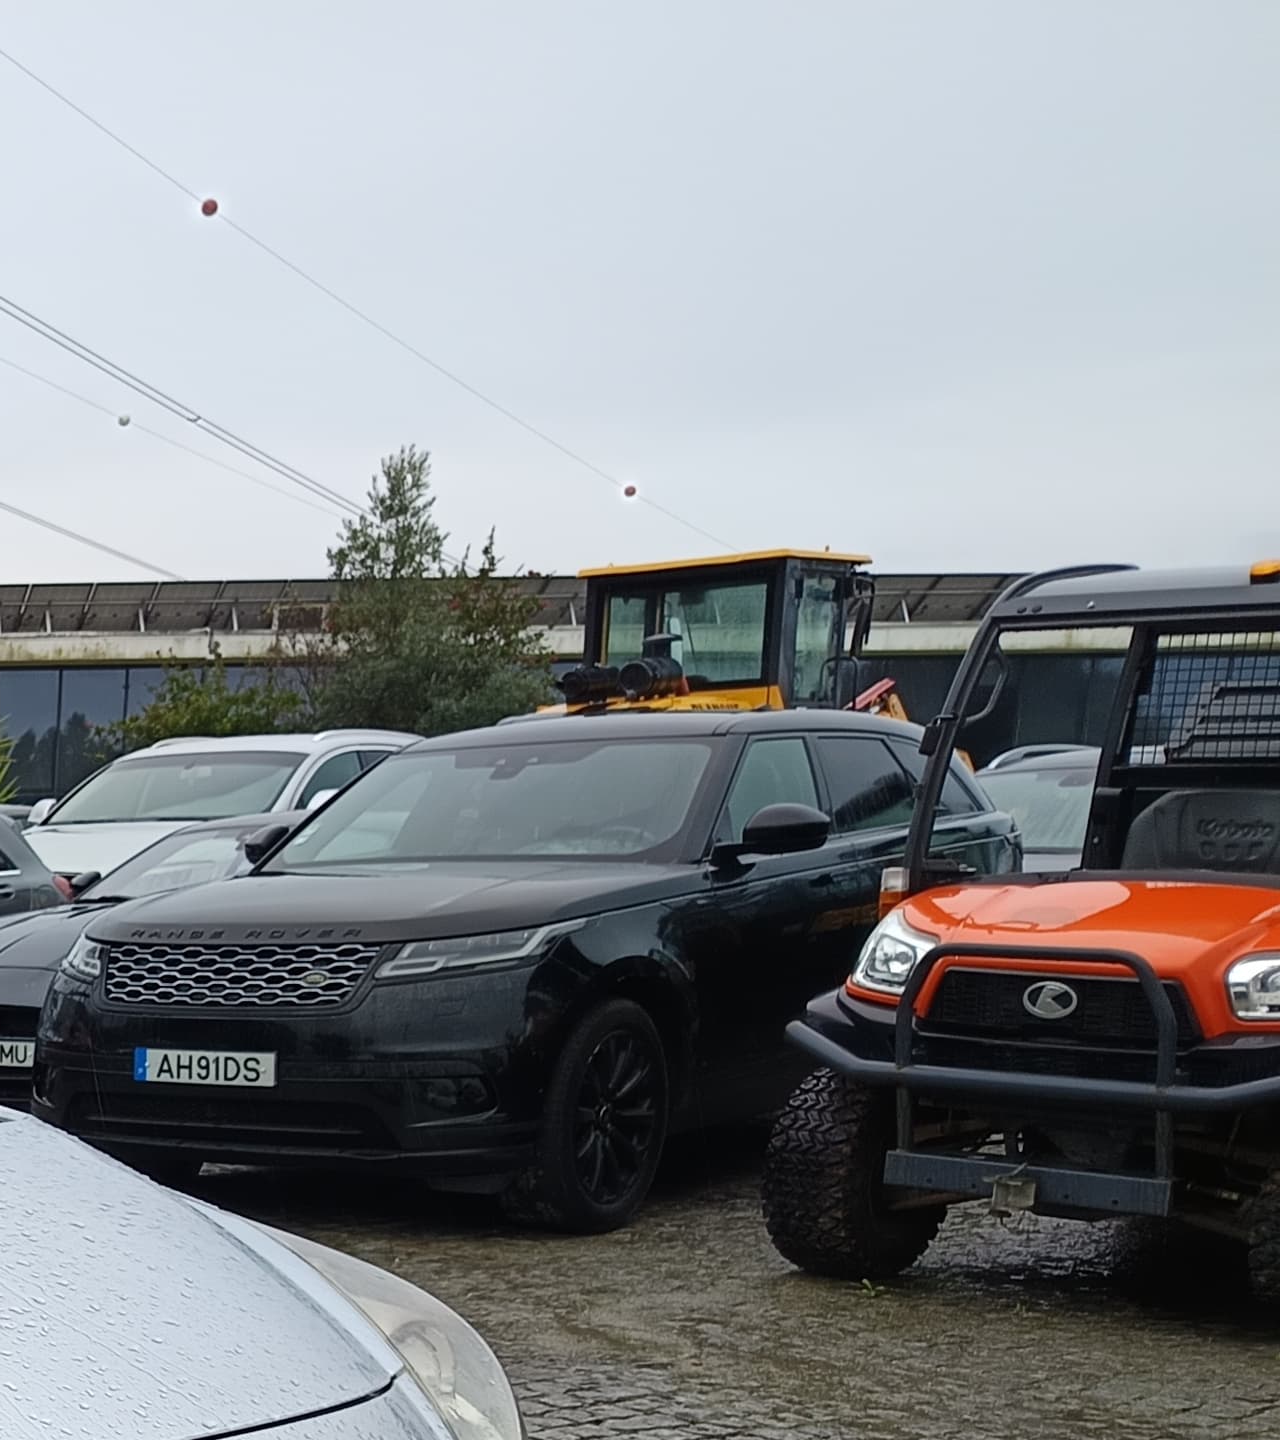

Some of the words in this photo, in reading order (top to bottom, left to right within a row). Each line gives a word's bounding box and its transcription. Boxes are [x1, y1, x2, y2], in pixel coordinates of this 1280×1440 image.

[130, 928, 226, 940] RANGE
[244, 928, 363, 939] ROVER
[156, 1056, 261, 1083] AH91DS
